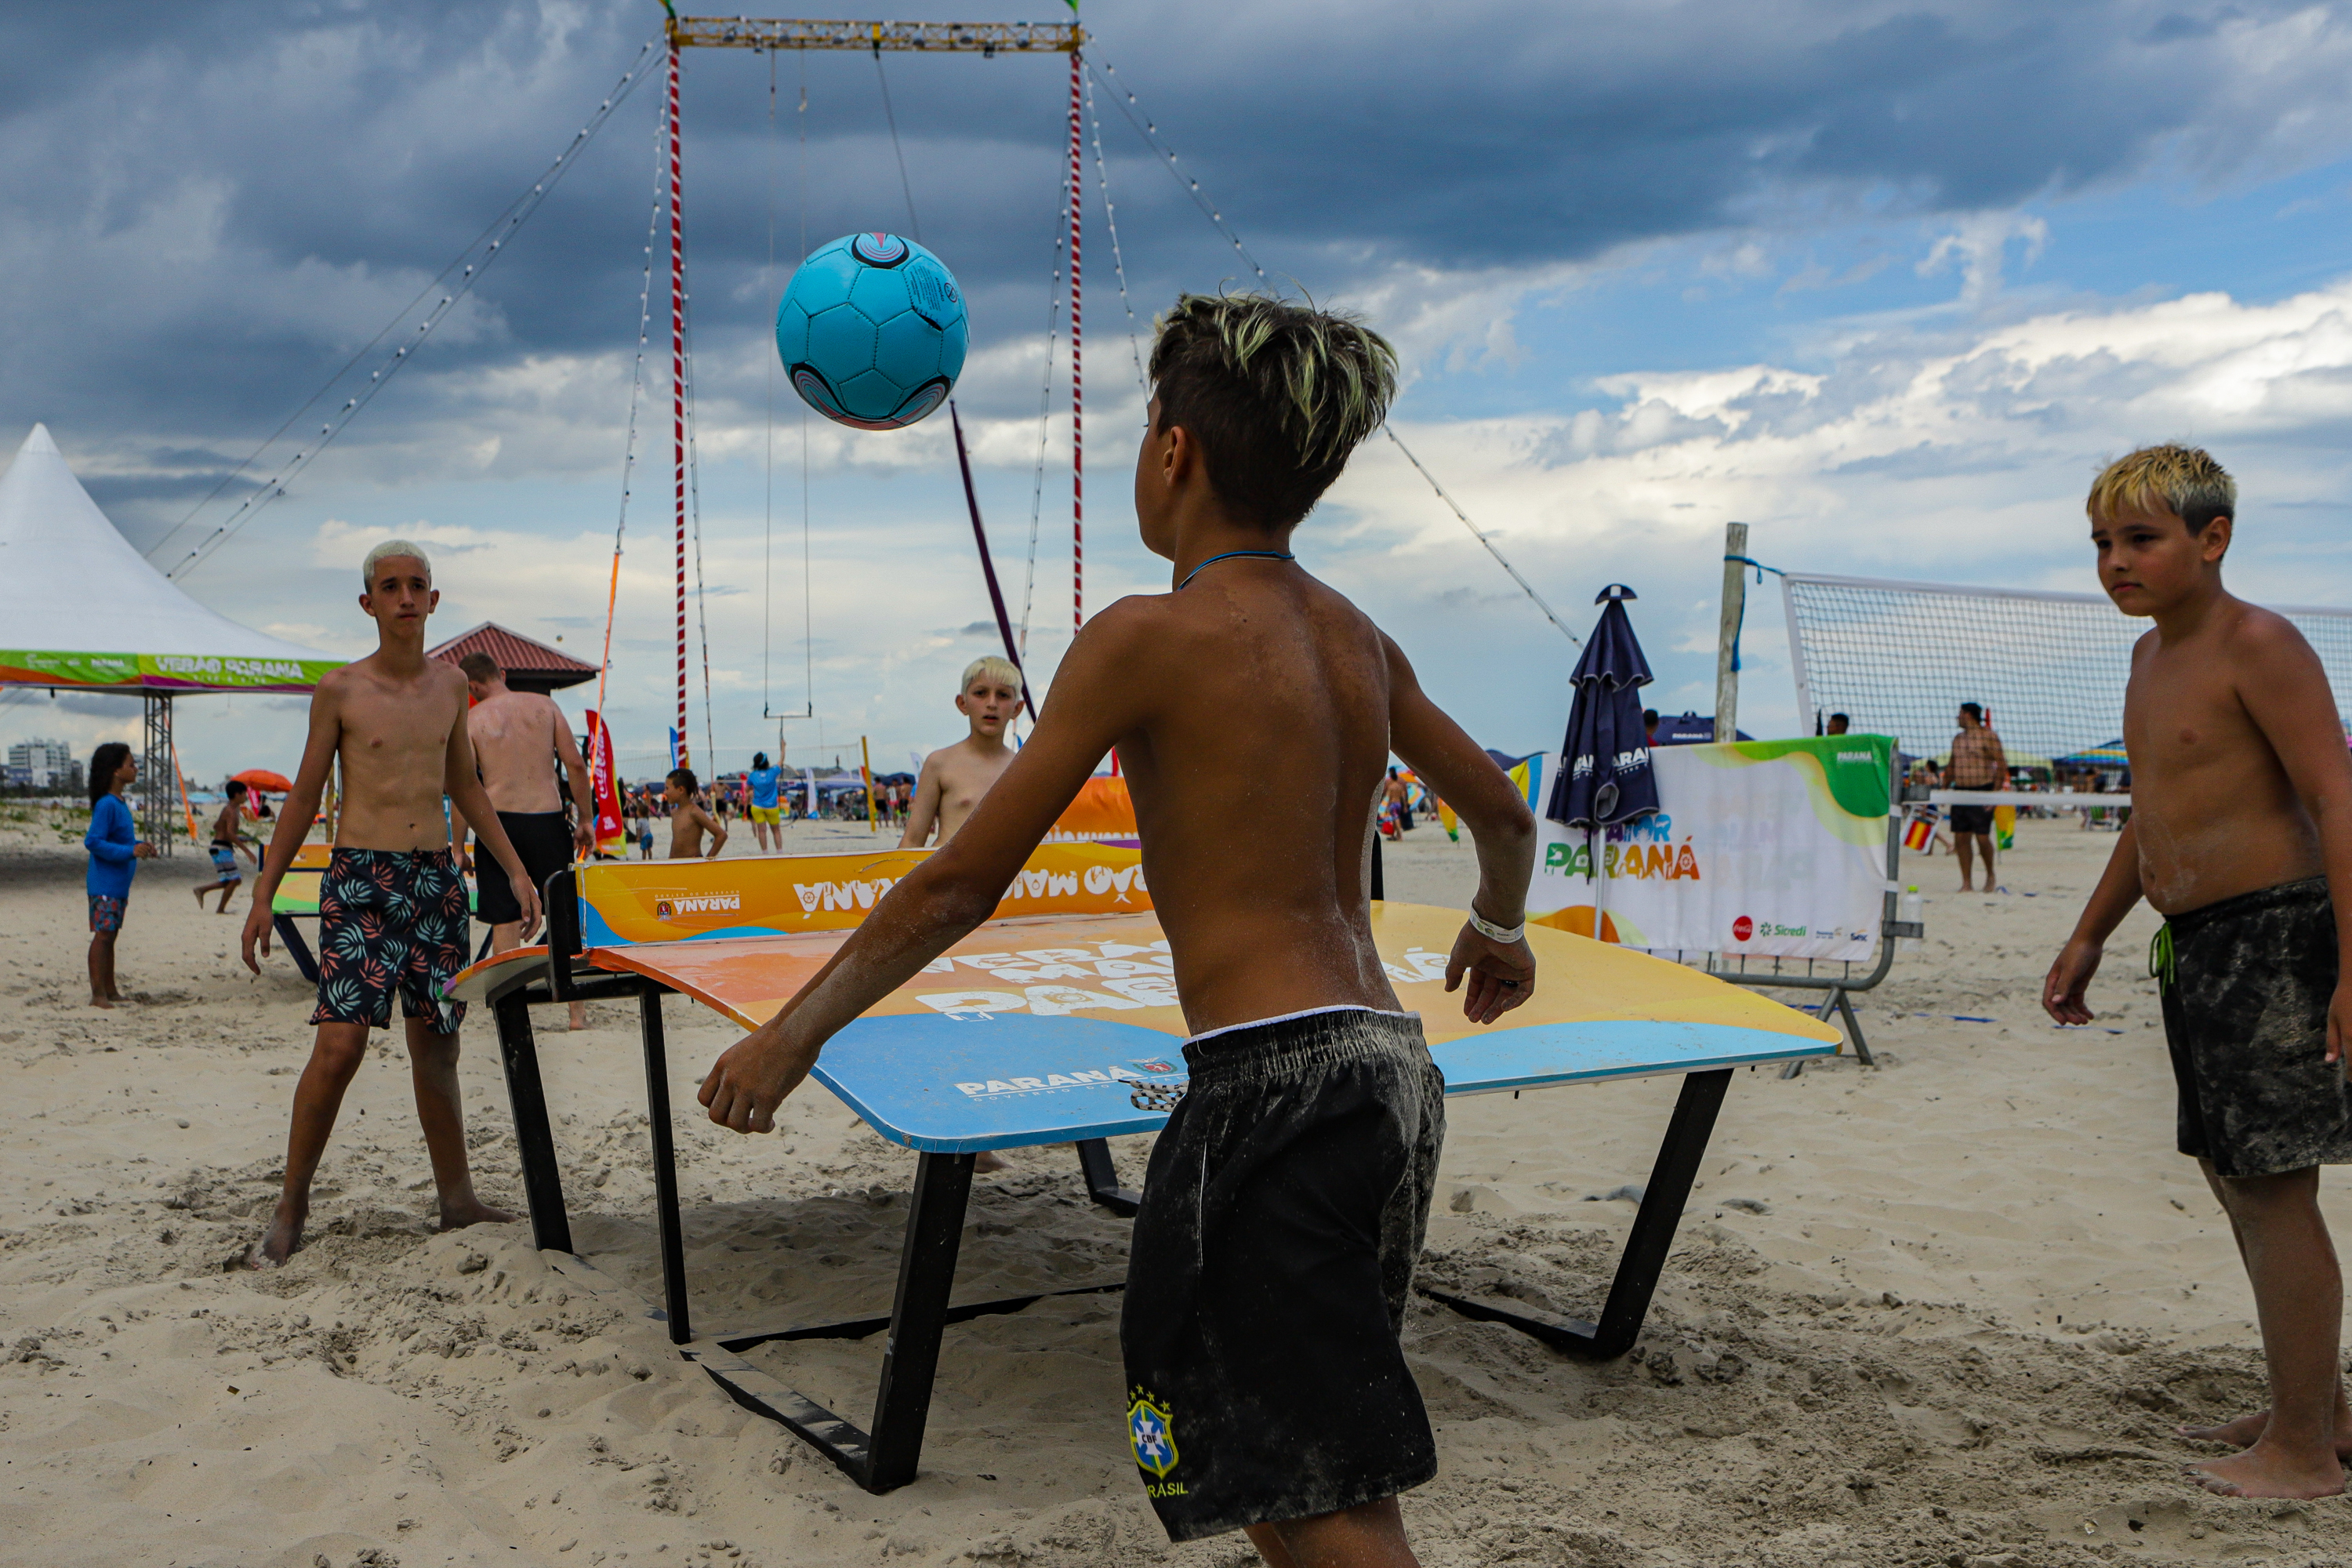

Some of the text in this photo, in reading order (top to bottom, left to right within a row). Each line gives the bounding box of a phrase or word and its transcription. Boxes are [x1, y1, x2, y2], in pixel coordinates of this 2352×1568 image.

[673, 897, 741, 916] PARANÁ
[1774, 924, 1807, 938] Sicredi
[953, 1065, 1144, 1096] PARANÁ
[973, 1087, 1071, 1103] GOVERNO
[1142, 1434, 1157, 1444] CBF
[1146, 1481, 1189, 1498] RASIL
